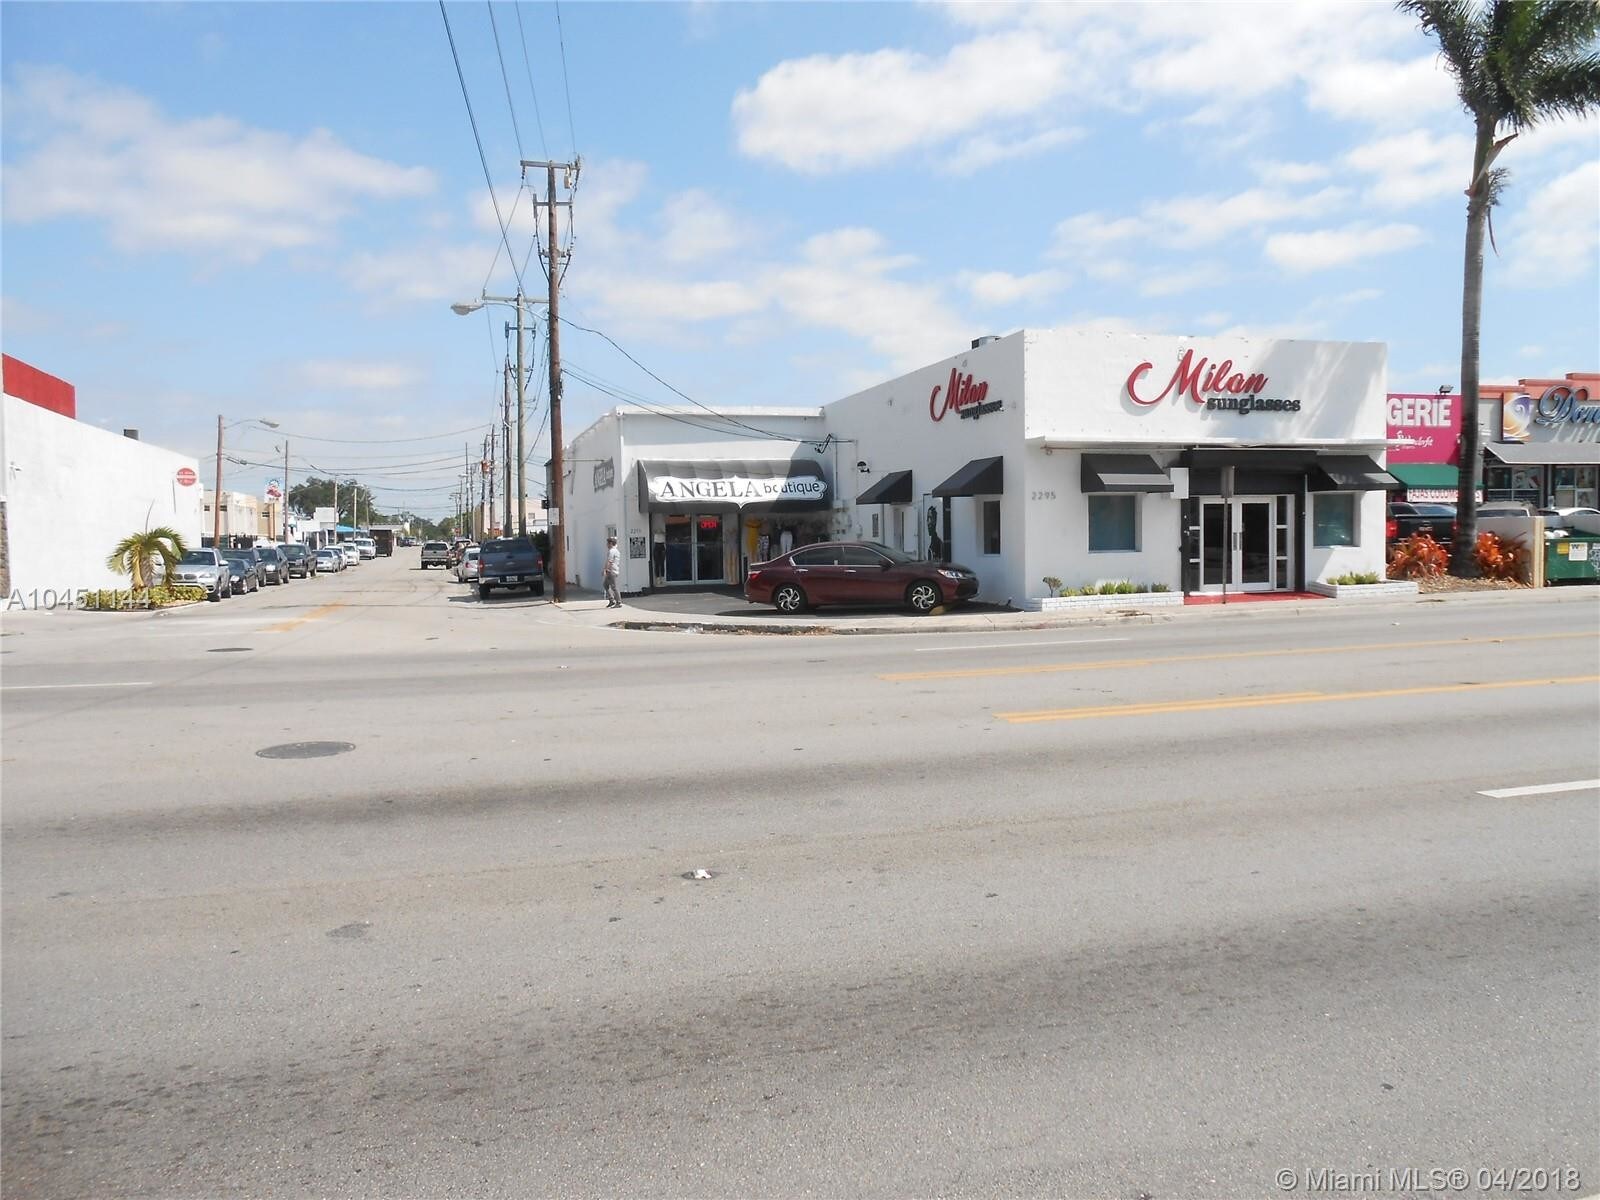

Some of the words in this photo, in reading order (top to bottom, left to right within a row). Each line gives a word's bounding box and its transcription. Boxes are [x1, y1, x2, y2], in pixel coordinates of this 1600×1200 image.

[1126, 348, 1268, 406] Milan
[929, 367, 988, 422] Milan
[1206, 394, 1301, 415] sunglasses
[659, 480, 763, 498] ANGELA
[763, 481, 820, 496] boutique
[1031, 490, 1057, 501] 2295
